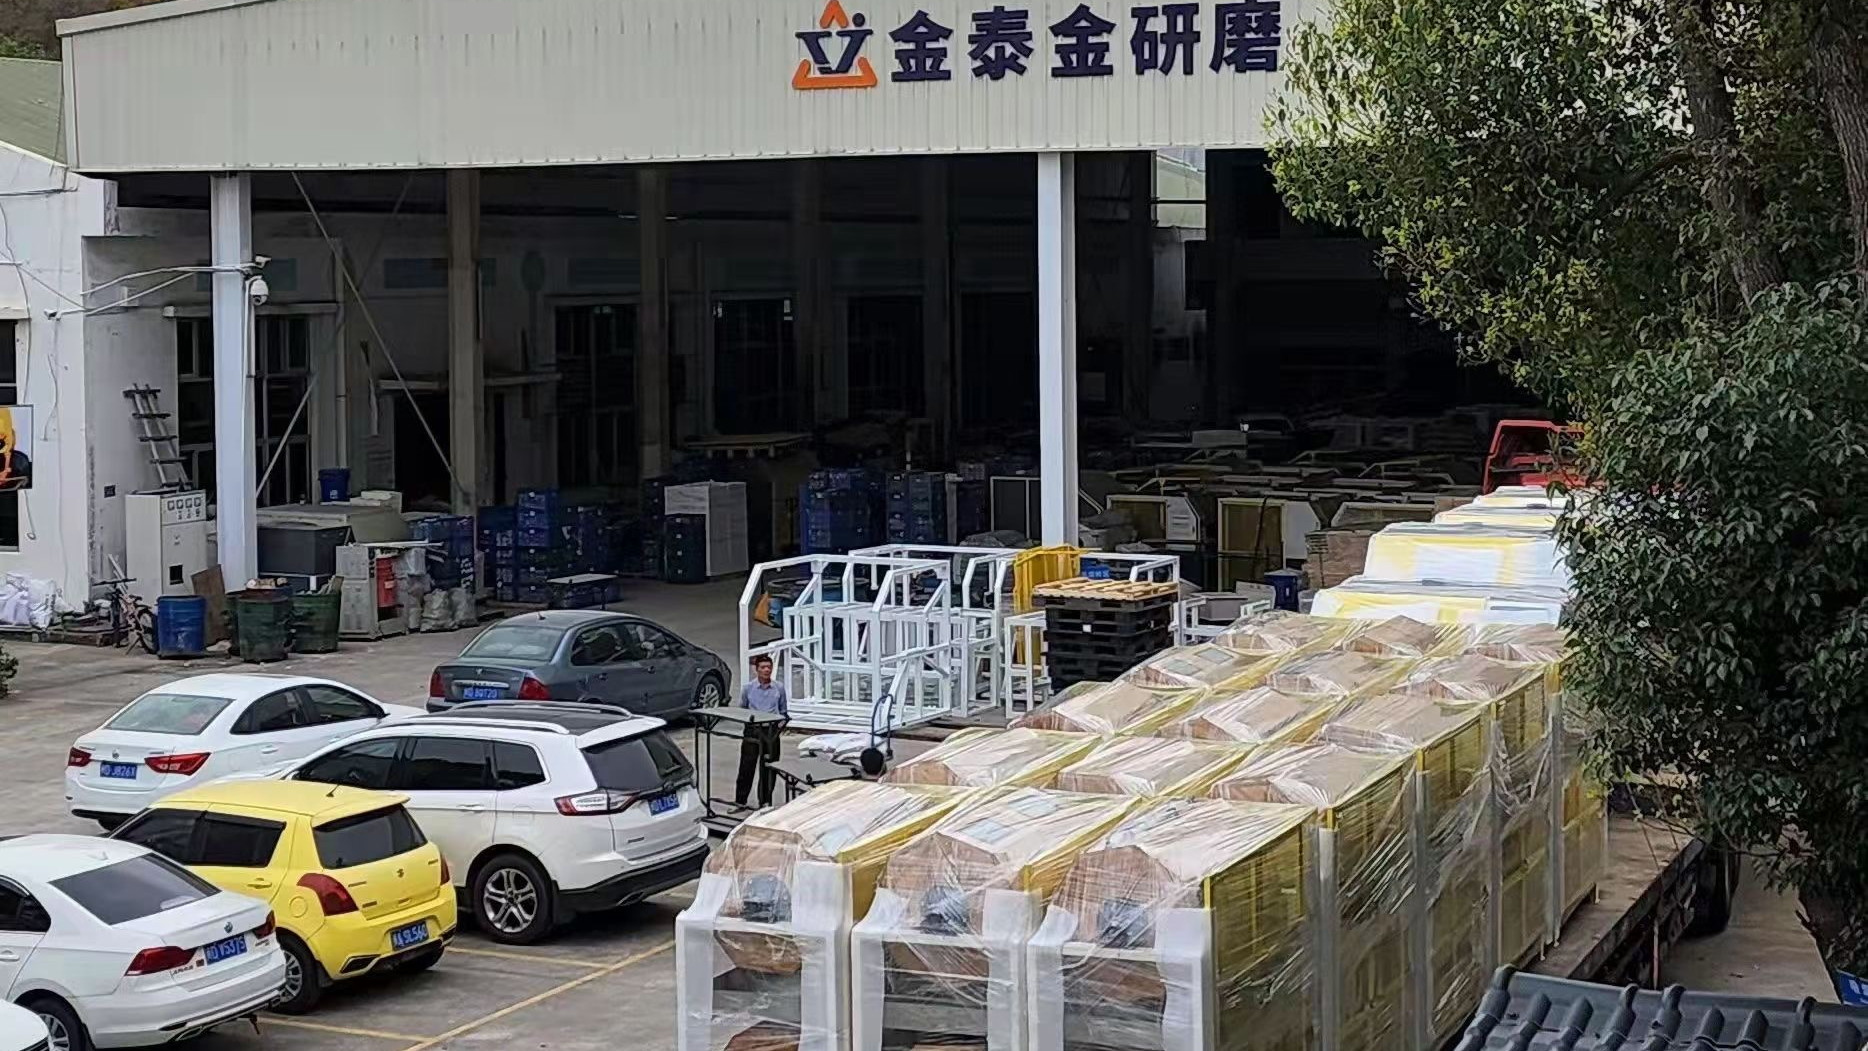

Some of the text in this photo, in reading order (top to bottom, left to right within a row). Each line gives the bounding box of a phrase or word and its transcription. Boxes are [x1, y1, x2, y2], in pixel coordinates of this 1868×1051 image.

[889, 0, 1282, 82] 金泰金研磨
